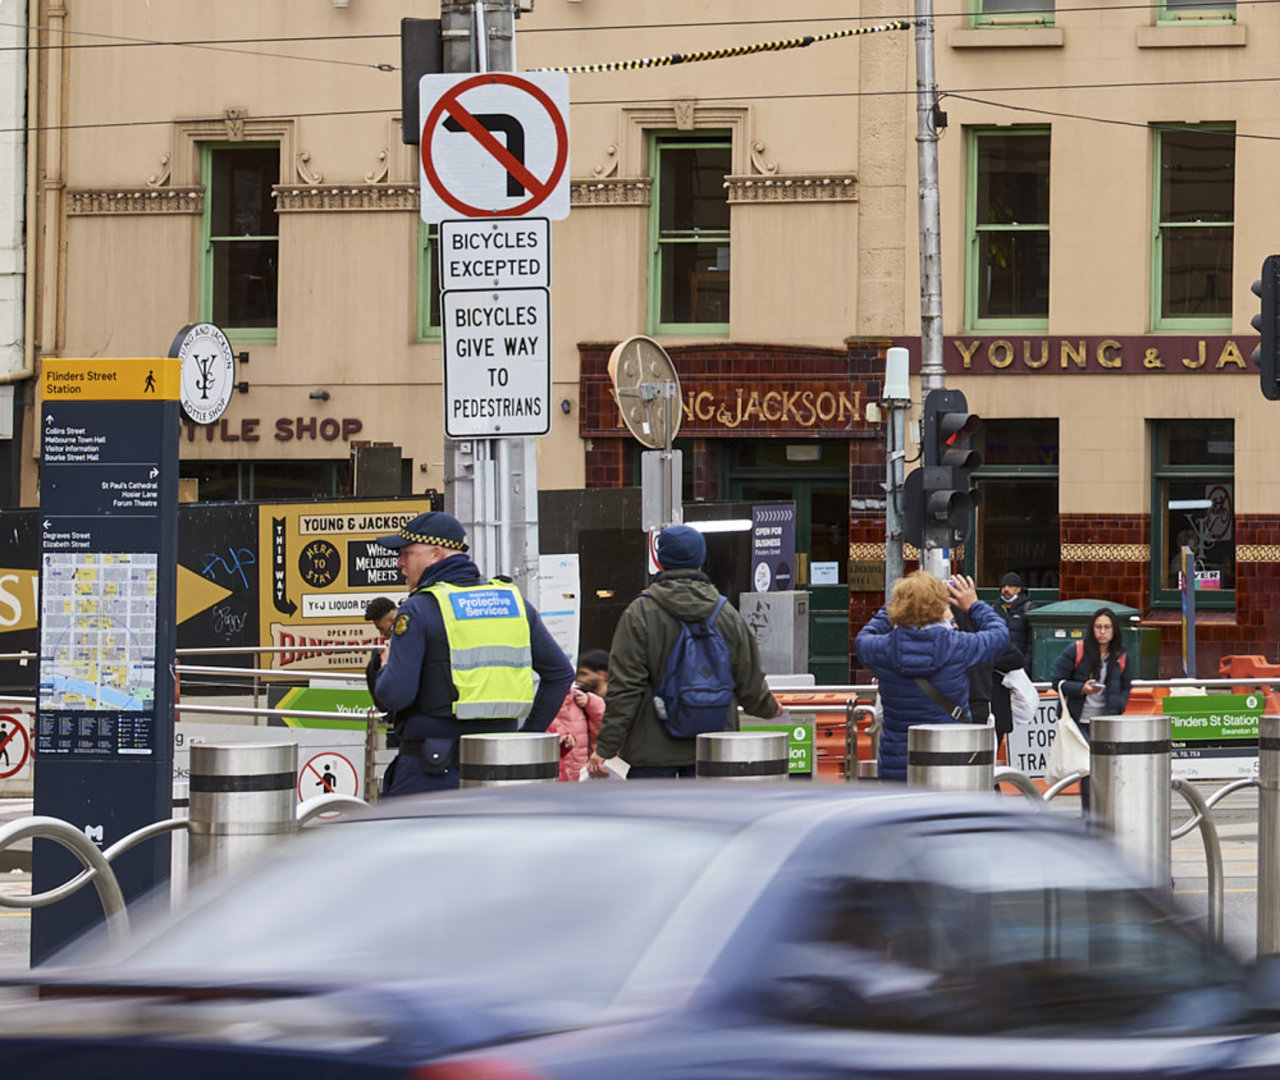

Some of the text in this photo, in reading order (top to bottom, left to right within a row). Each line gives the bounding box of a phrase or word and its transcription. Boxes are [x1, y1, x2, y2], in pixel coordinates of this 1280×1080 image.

[452, 231, 538, 252] BICYCLES
[450, 258, 541, 278] EXCEPTED
[455, 306, 537, 329] BICYCLES
[195, 325, 209, 337] AND
[211, 329, 232, 370] JACKSON
[456, 334, 539, 359] GIVE WAY
[953, 340, 1123, 369] YOUNG
[1143, 347, 1165, 369] &
[46, 370, 117, 381] Flinders Street
[487, 367, 510, 388] TO
[46, 384, 82, 394] Station
[183, 396, 226, 422] BOTTLE SHOP
[453, 396, 542, 419] PEDESTRIANS
[724, 388, 862, 428] JACKSON
[45, 427, 66, 435] Collins
[274, 417, 364, 442] SHOP
[45, 436, 77, 444] Melbourne
[94, 436, 106, 444] Hall
[45, 445, 64, 453] Visitor
[128, 481, 158, 489] Cathedral
[113, 499, 158, 507] Forum Theatre
[304, 518, 344, 531] YOUNG
[347, 517, 355, 530] &
[43, 532, 70, 540] Degraves
[755, 526, 782, 536] OPEN FOR
[43, 540, 70, 548] Elizabeth
[755, 538, 781, 547] BUSINESS
[306, 543, 333, 560] HERE
[314, 559, 326, 569] TO
[355, 557, 398, 571] MELBOUR
[306, 570, 332, 584] STAY
[367, 570, 398, 584] MEETS
[275, 571, 284, 601] WAY
[328, 599, 359, 610] LIQUOR
[458, 597, 512, 608] Protective
[465, 606, 509, 617] Services
[328, 628, 363, 637] OPEN FOR
[328, 657, 363, 665] BUSINESS
[1209, 715, 1222, 726] St
[1223, 714, 1259, 726] Station
[1221, 727, 1251, 736] Swanston
[1028, 730, 1057, 748] FOR
[1017, 752, 1046, 771] TRA
